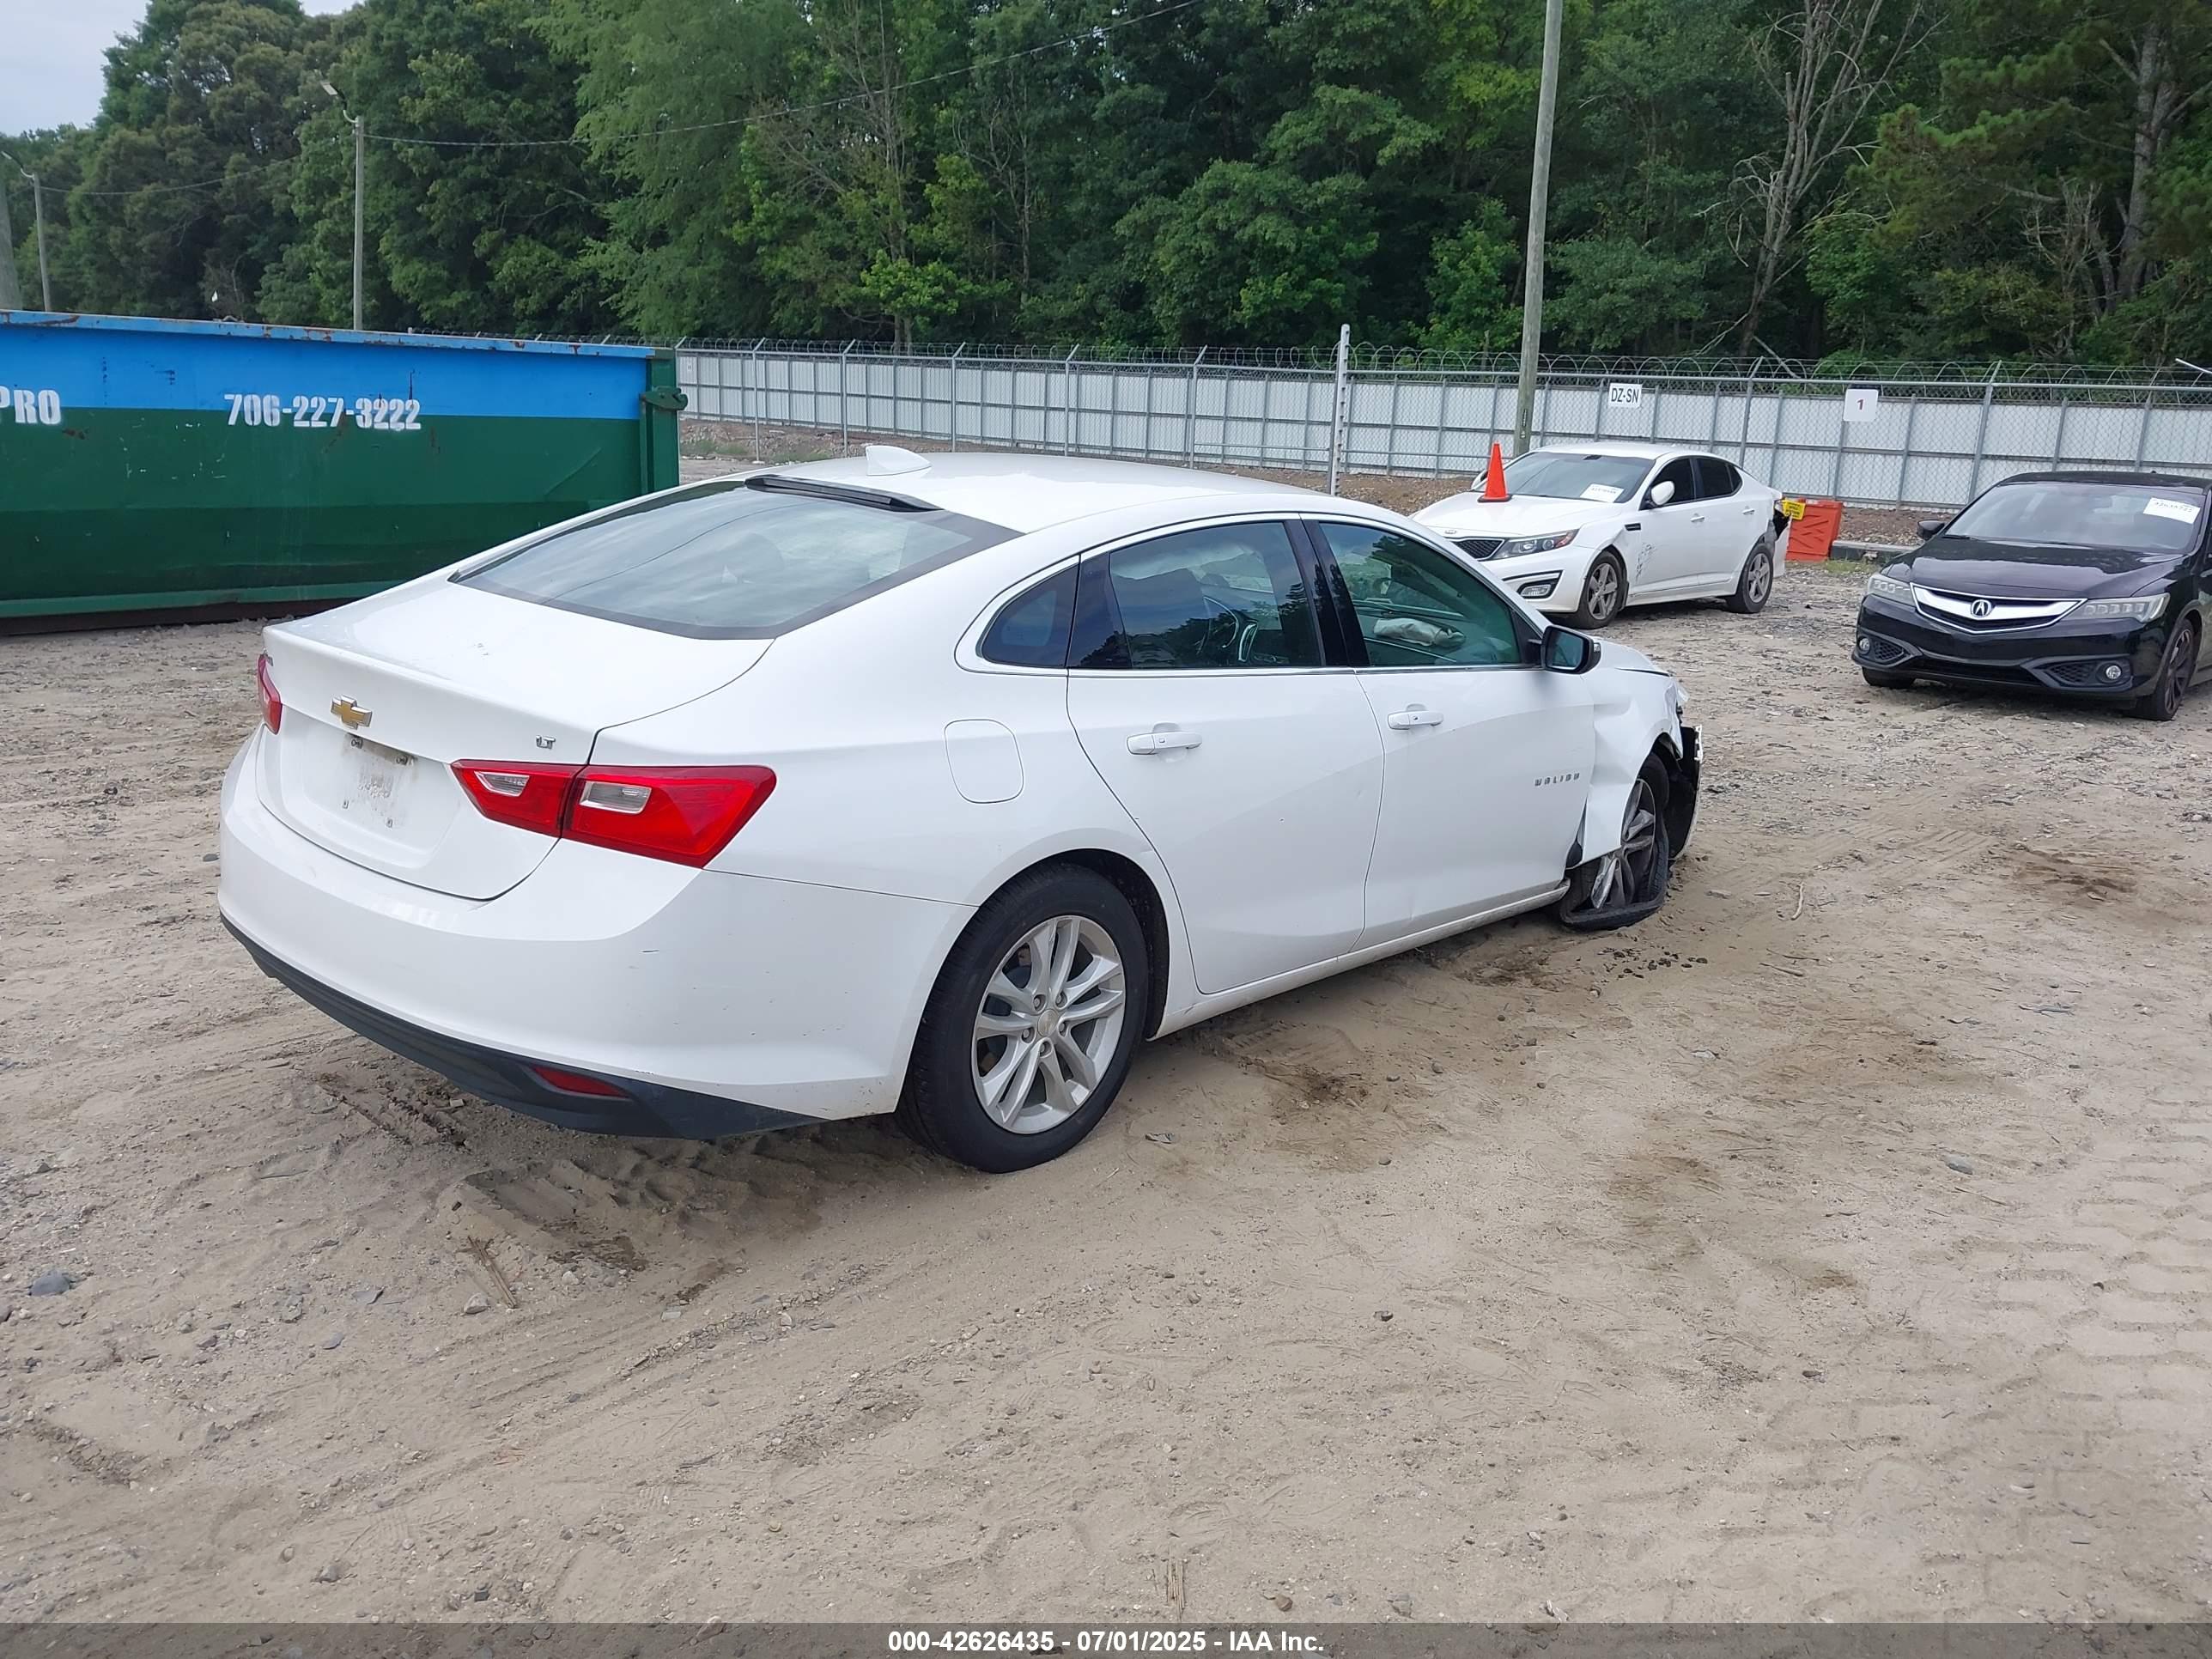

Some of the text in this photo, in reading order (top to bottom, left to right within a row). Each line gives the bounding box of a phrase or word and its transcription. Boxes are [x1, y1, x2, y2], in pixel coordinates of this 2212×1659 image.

[1611, 387, 1639, 403] DZ-SN
[1856, 398, 1864, 410] 1
[224, 393, 422, 431] 706-227-3222
[536, 735, 556, 750] LT
